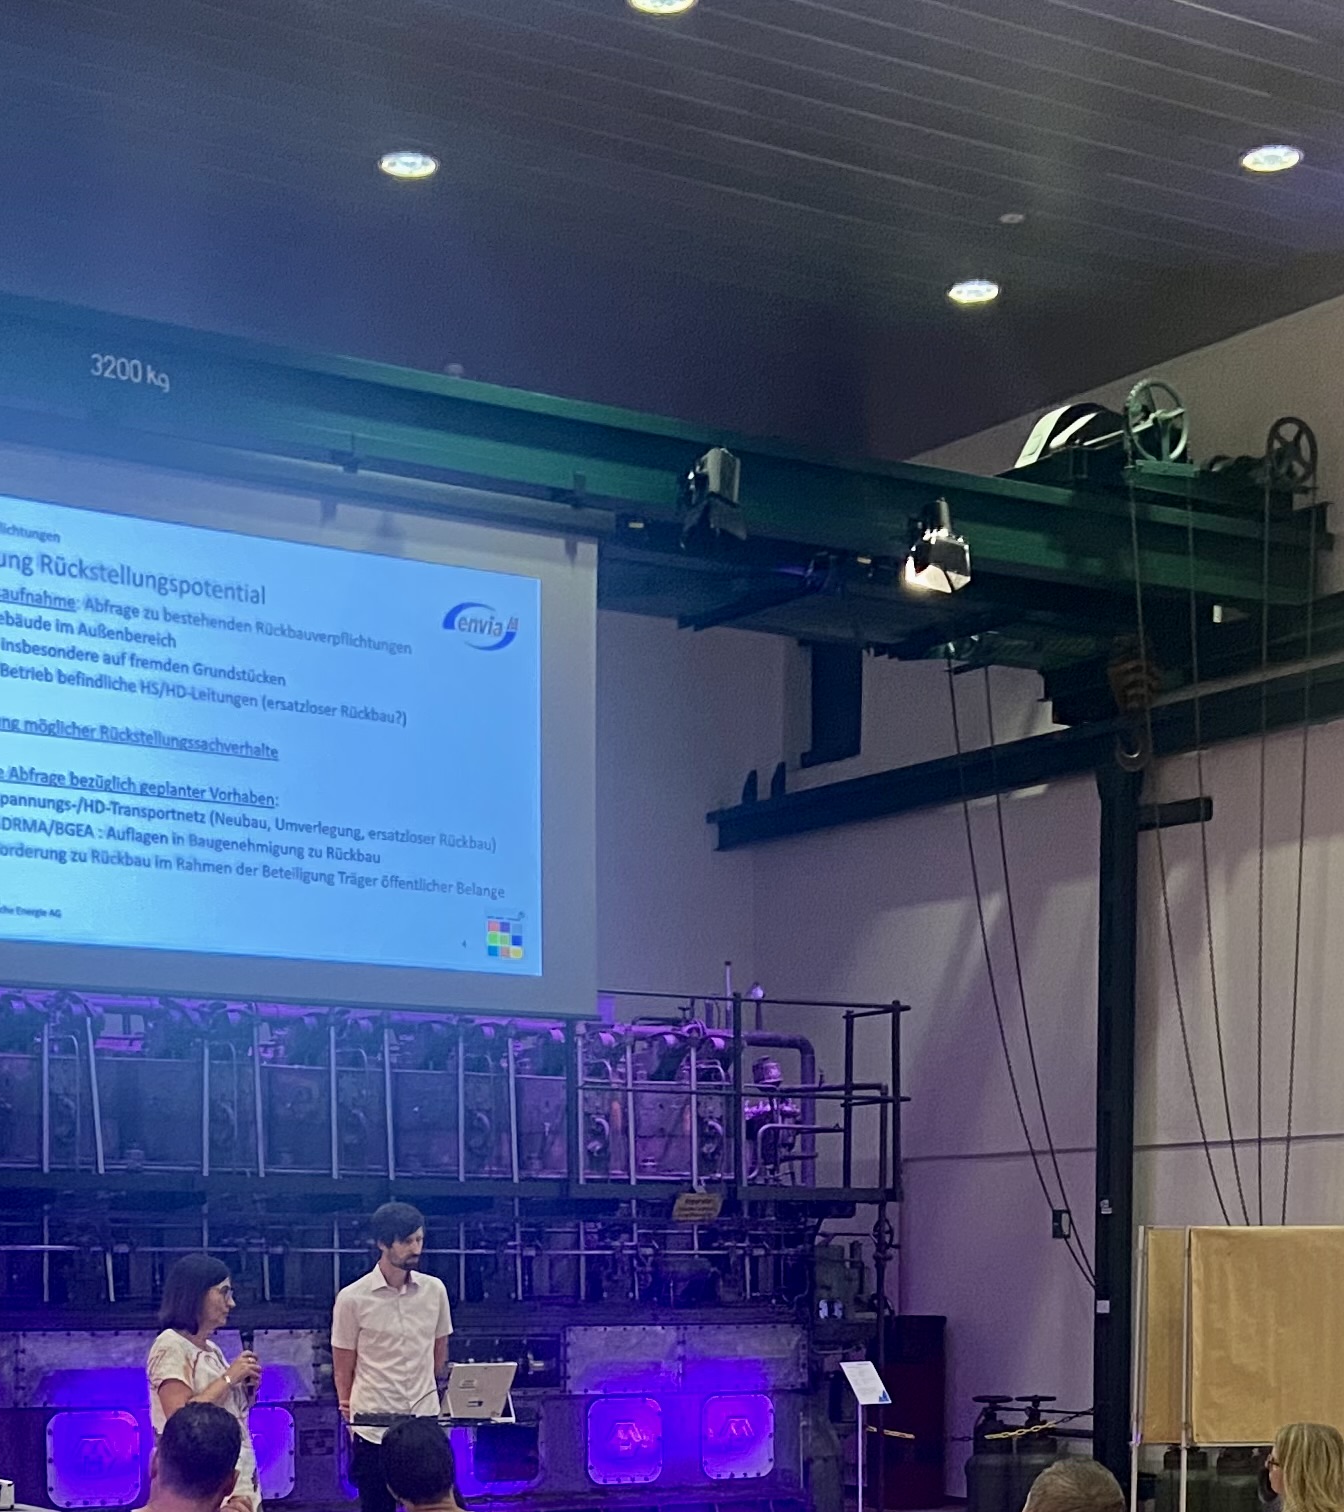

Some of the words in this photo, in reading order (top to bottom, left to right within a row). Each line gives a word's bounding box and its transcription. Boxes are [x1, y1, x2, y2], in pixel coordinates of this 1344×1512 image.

[90, 353, 143, 383] 3200
[146, 365, 170, 393] kg
[40, 554, 265, 604] Rückstellungspotential
[56, 619, 74, 635] im
[77, 621, 176, 648] Außenbereich
[84, 598, 139, 619] Abfrage
[144, 608, 159, 621] zu
[163, 607, 252, 632] bestehenden
[256, 622, 412, 655] Rückbauverpflichtungen
[0, 637, 99, 663] insbesondere
[103, 652, 126, 666] auf
[130, 653, 189, 675] fremden
[193, 663, 286, 686] Grundstücken
[0, 662, 54, 683] Betrieb
[57, 669, 137, 693] befindliche
[140, 680, 257, 708] HS/HD-Leitungen
[262, 695, 337, 716] (ersatzloser
[340, 704, 407, 728] Rückbau?)
[24, 717, 96, 740] möglicher
[100, 725, 279, 761] Rückstellungssachverhalte
[9, 766, 66, 787] Abfrage
[70, 771, 136, 795] bezüglich
[140, 781, 205, 801] geplanter
[209, 786, 279, 808] Vorhaben:
[106, 826, 168, 846] Auflagen
[172, 832, 184, 846] in
[189, 833, 304, 860] Baugenehmigung
[308, 847, 322, 859] zu
[327, 846, 381, 865] Rückbau
[210, 810, 271, 831] (Neubau,
[275, 817, 365, 841] Umverlegung,
[368, 829, 436, 846] ersatzloser
[439, 834, 497, 854] Rückbau)
[71, 850, 87, 863] zu
[91, 849, 151, 868] Rückbau
[155, 856, 173, 870] im
[176, 857, 232, 874] Rahmen
[236, 862, 258, 876] der
[262, 865, 335, 886] Beteiligung
[338, 870, 378, 889] Träger
[381, 875, 453, 894] öffentlicher
[456, 881, 505, 901] Belange
